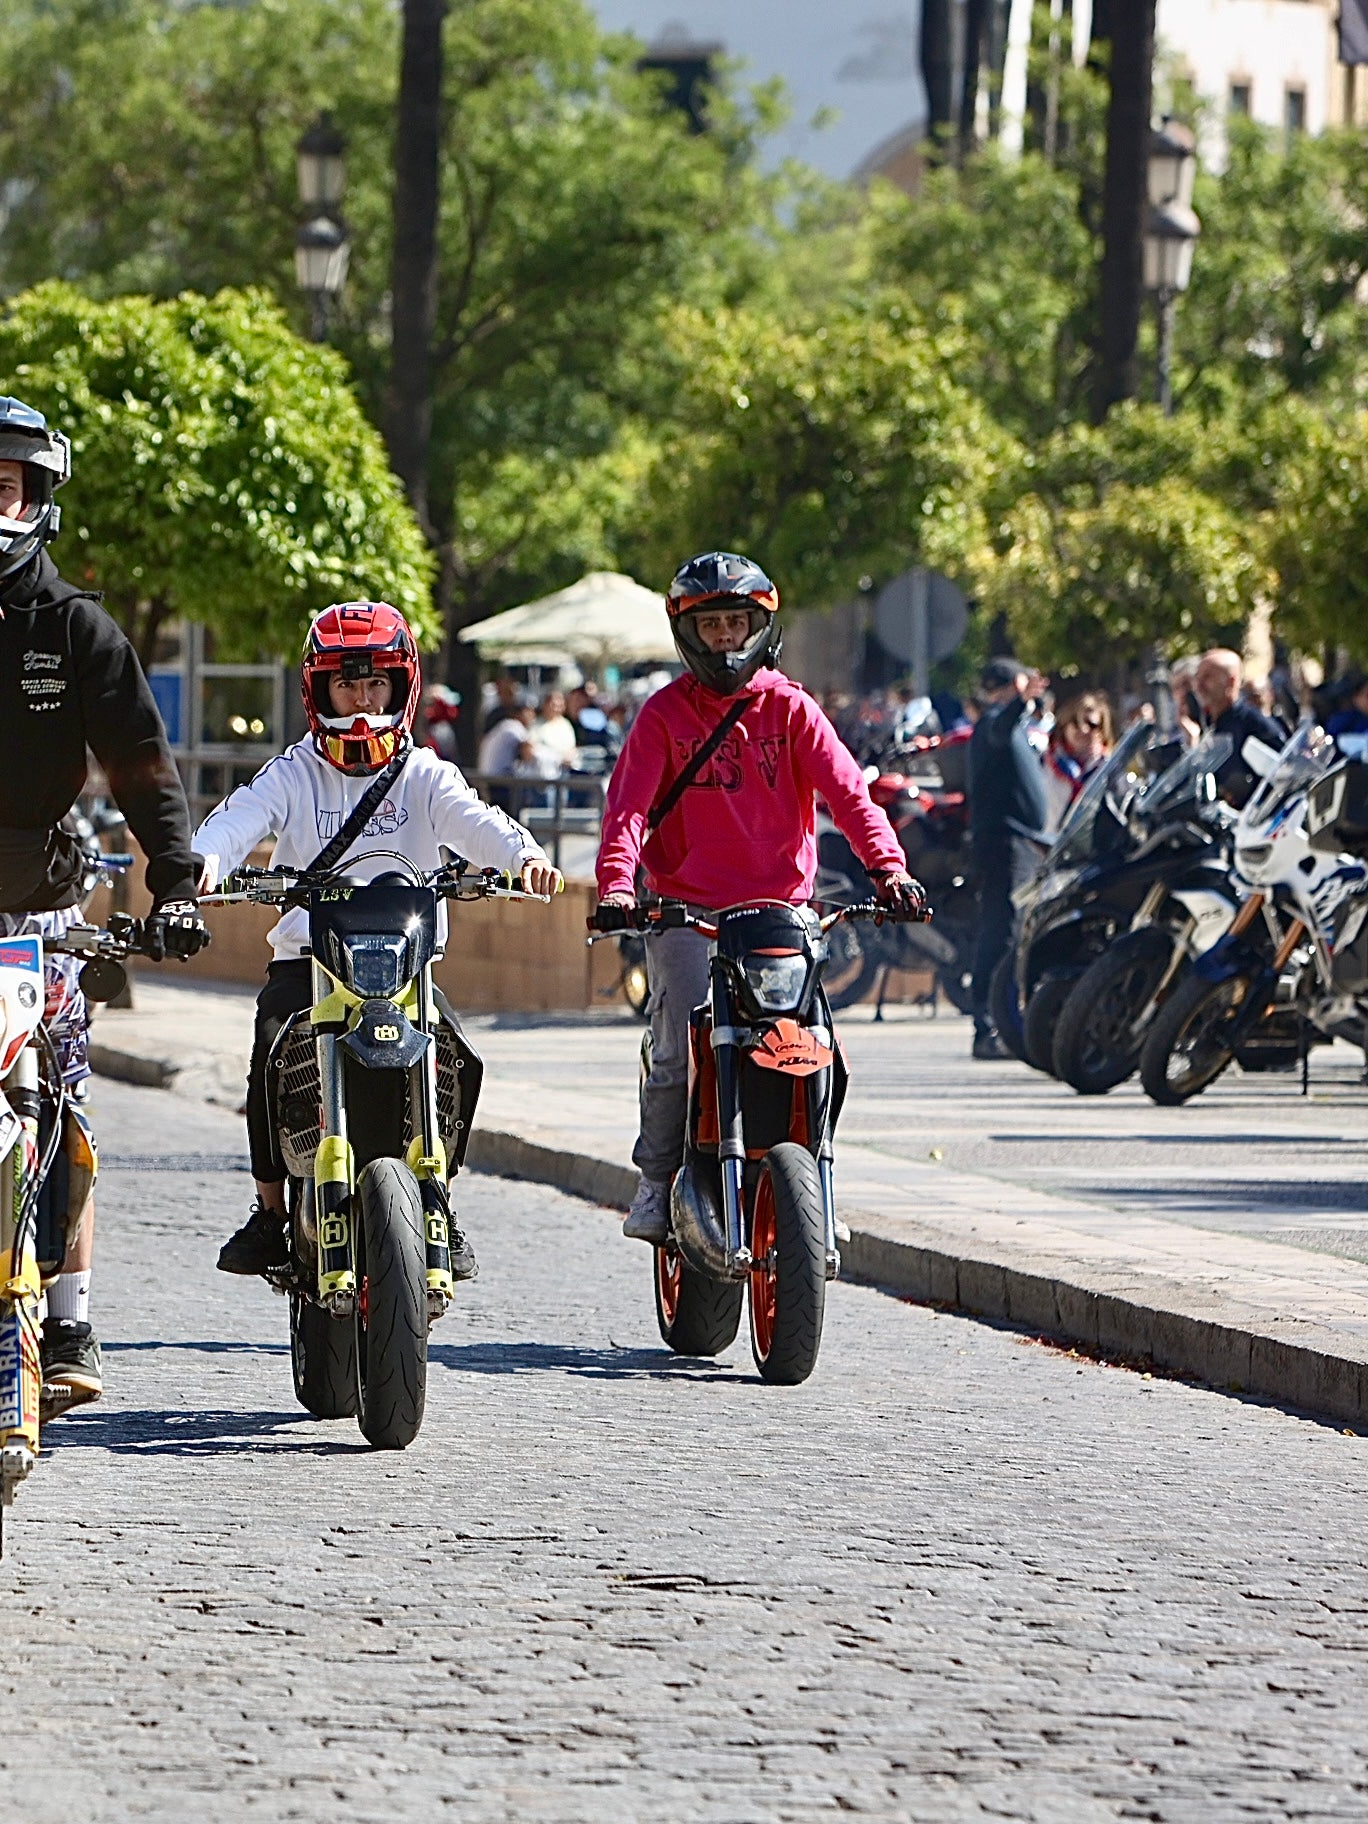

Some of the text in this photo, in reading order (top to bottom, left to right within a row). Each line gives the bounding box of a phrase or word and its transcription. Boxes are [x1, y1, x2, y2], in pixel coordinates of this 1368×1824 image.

[673, 734, 787, 793] LSV
[319, 888, 354, 902] LSV
[169, 916, 205, 931] FOX
